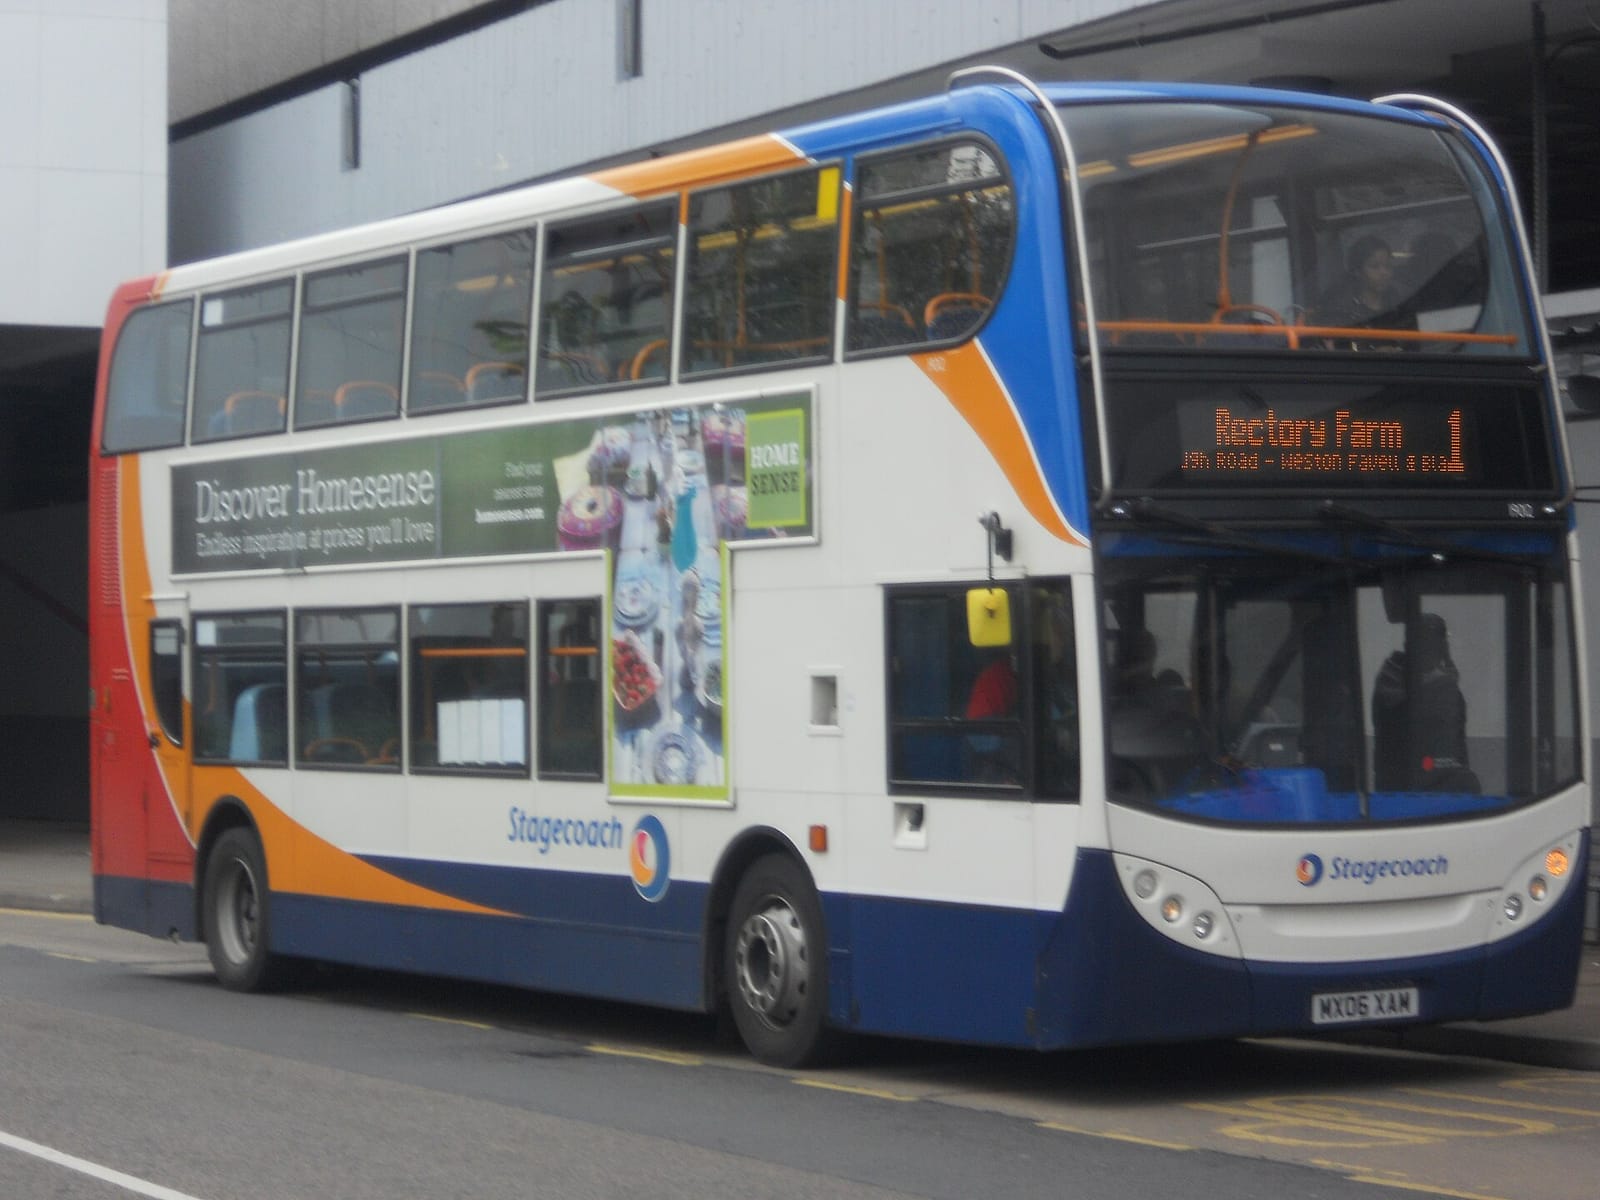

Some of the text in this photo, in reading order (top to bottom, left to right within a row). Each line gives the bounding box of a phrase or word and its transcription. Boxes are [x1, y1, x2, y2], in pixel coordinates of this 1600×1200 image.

[1215, 407, 1403, 449] Rectory Farm
[1447, 408, 1465, 473] 1
[750, 441, 800, 469] HOME
[1216, 452, 1259, 471] Road
[1280, 453, 1342, 472] Weston
[195, 468, 435, 524] Discover Homesense
[750, 471, 801, 497] SENSE
[196, 531, 242, 557] Endless
[308, 527, 321, 550] at
[403, 516, 435, 543] love
[508, 806, 624, 855] Stagecoach
[1329, 854, 1449, 885] Stagecoach
[1319, 990, 1412, 1019] MX06 XAM
